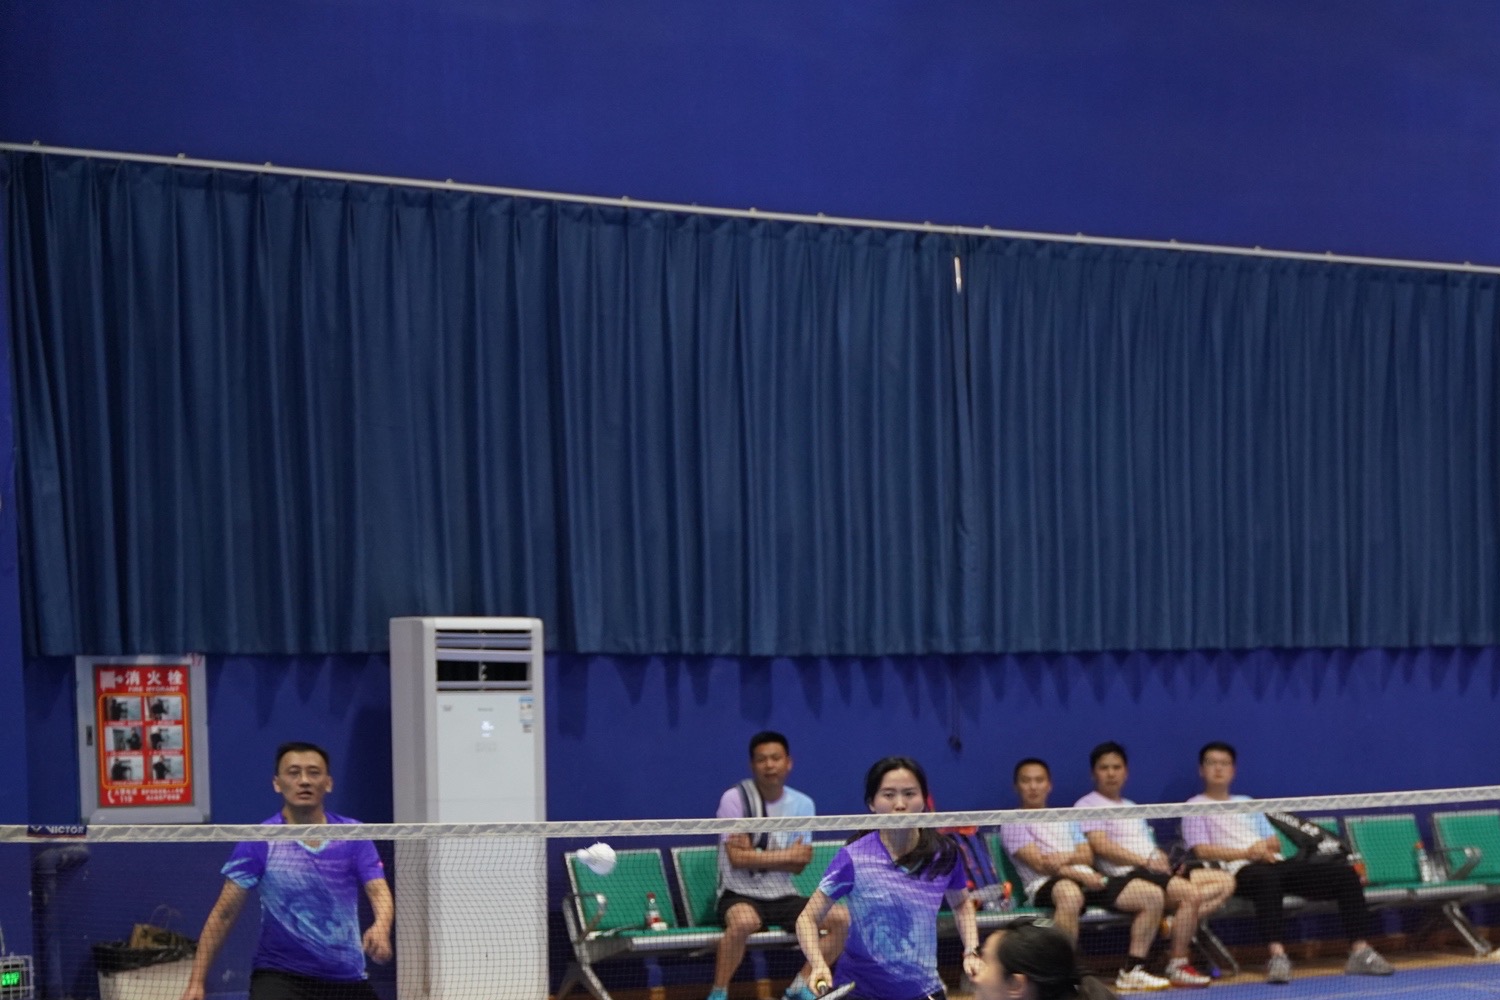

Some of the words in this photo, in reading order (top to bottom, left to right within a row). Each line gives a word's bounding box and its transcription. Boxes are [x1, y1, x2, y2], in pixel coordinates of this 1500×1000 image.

[125, 670, 183, 686] 消火栓
[46, 825, 84, 834] VICTOR
